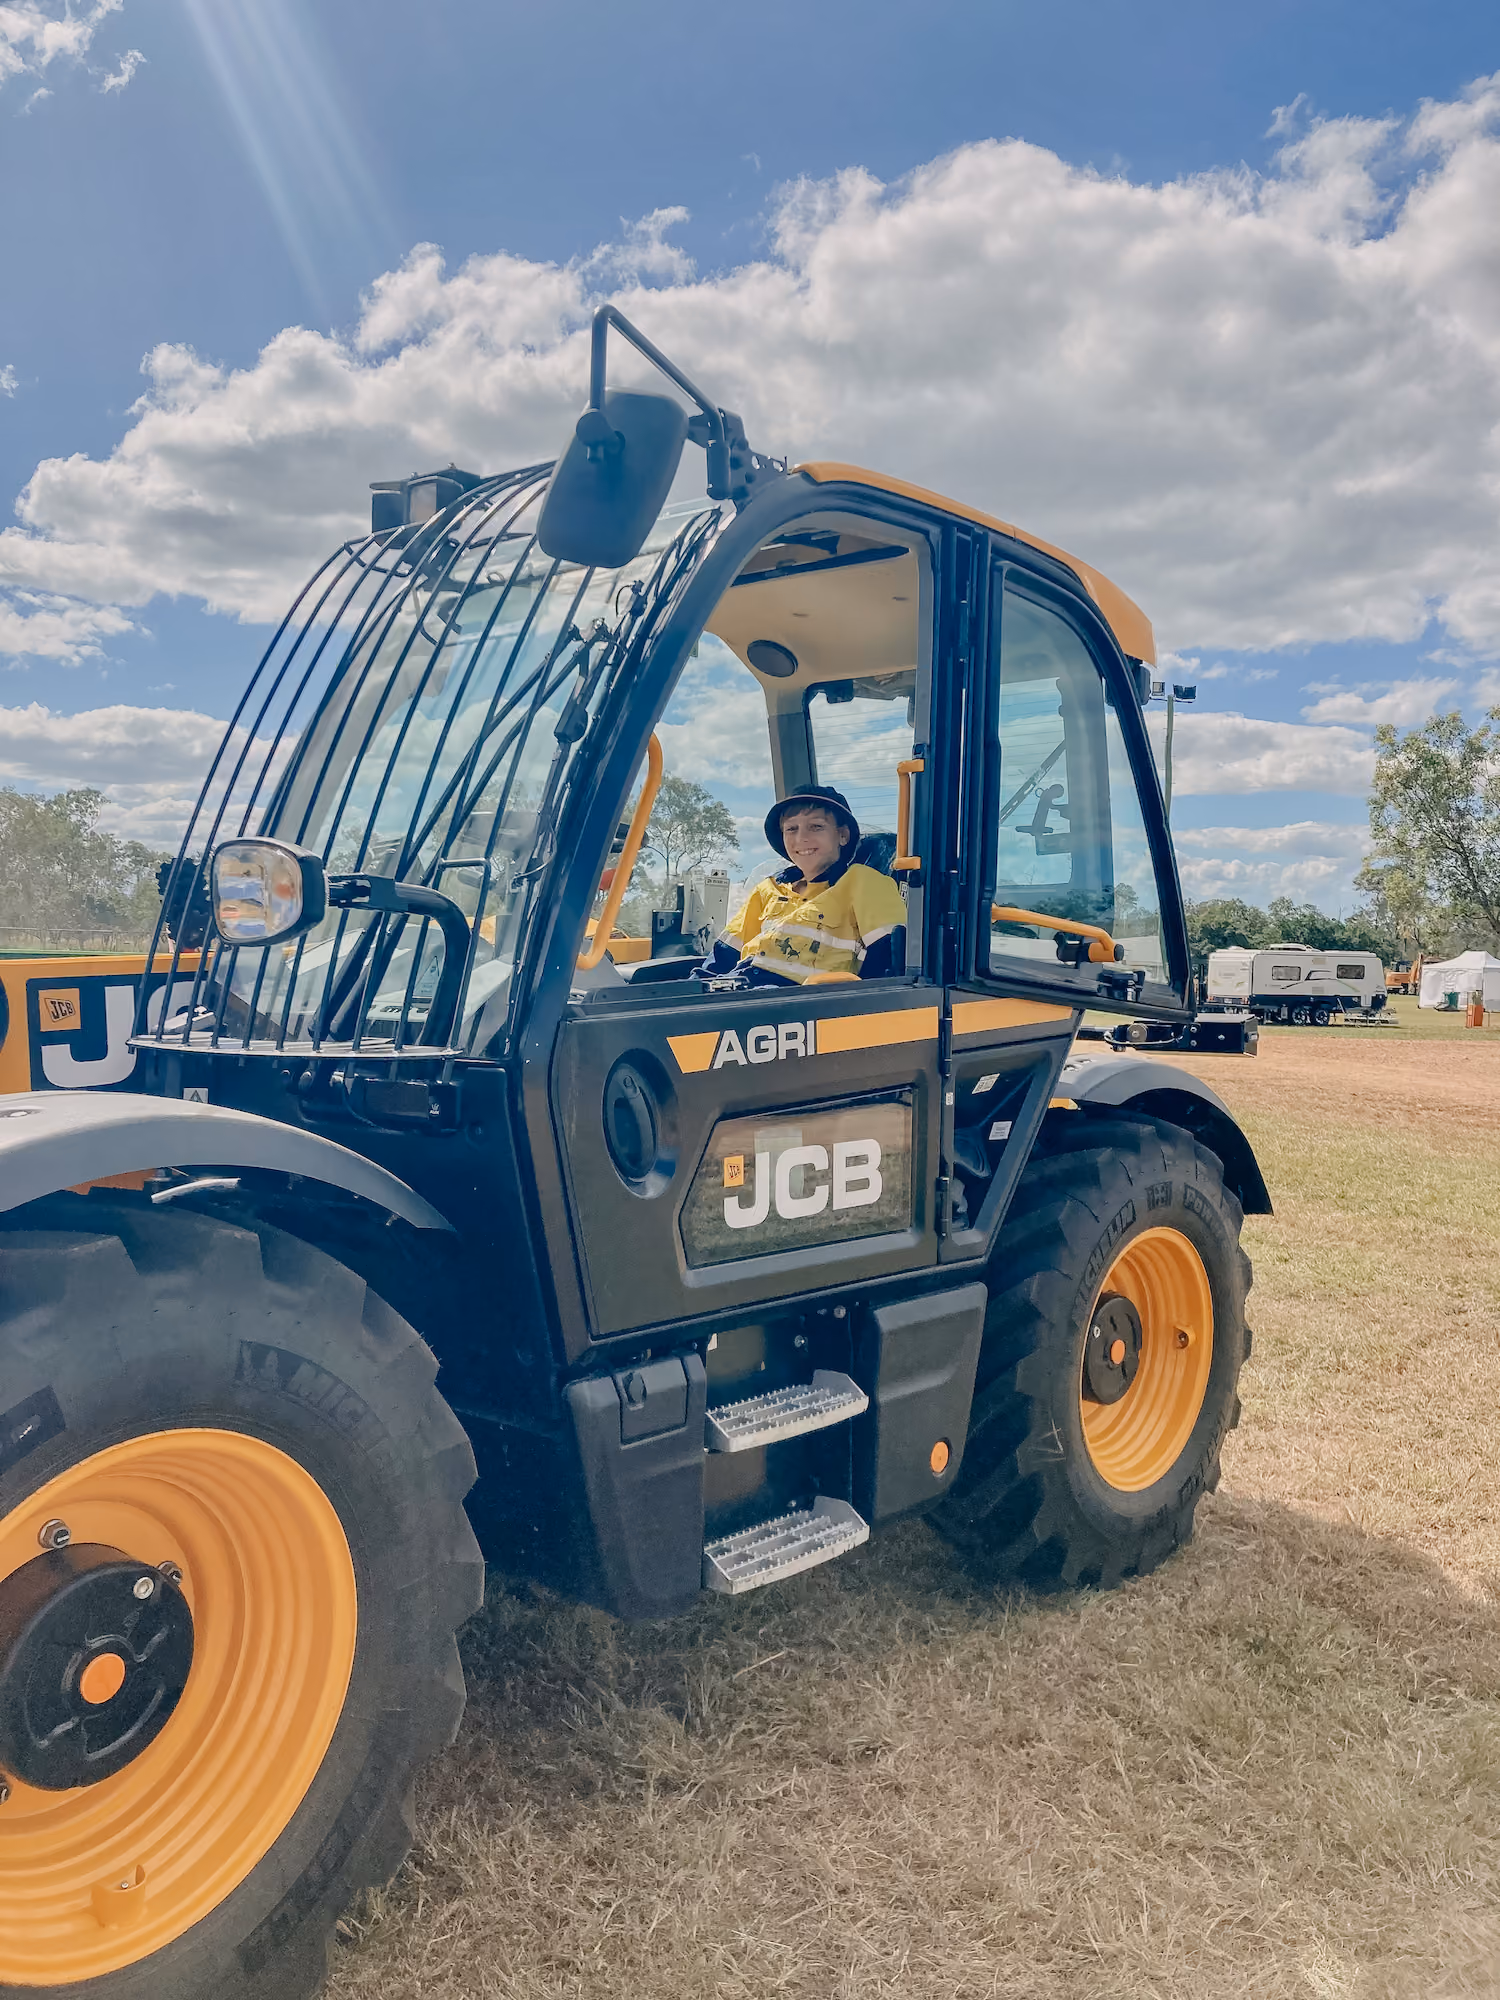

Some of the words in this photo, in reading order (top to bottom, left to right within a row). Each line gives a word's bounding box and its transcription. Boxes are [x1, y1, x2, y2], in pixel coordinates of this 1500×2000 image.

[50, 1000, 75, 1021] JCB
[713, 1020, 815, 1069] AGRI
[724, 1139, 882, 1229] JCB
